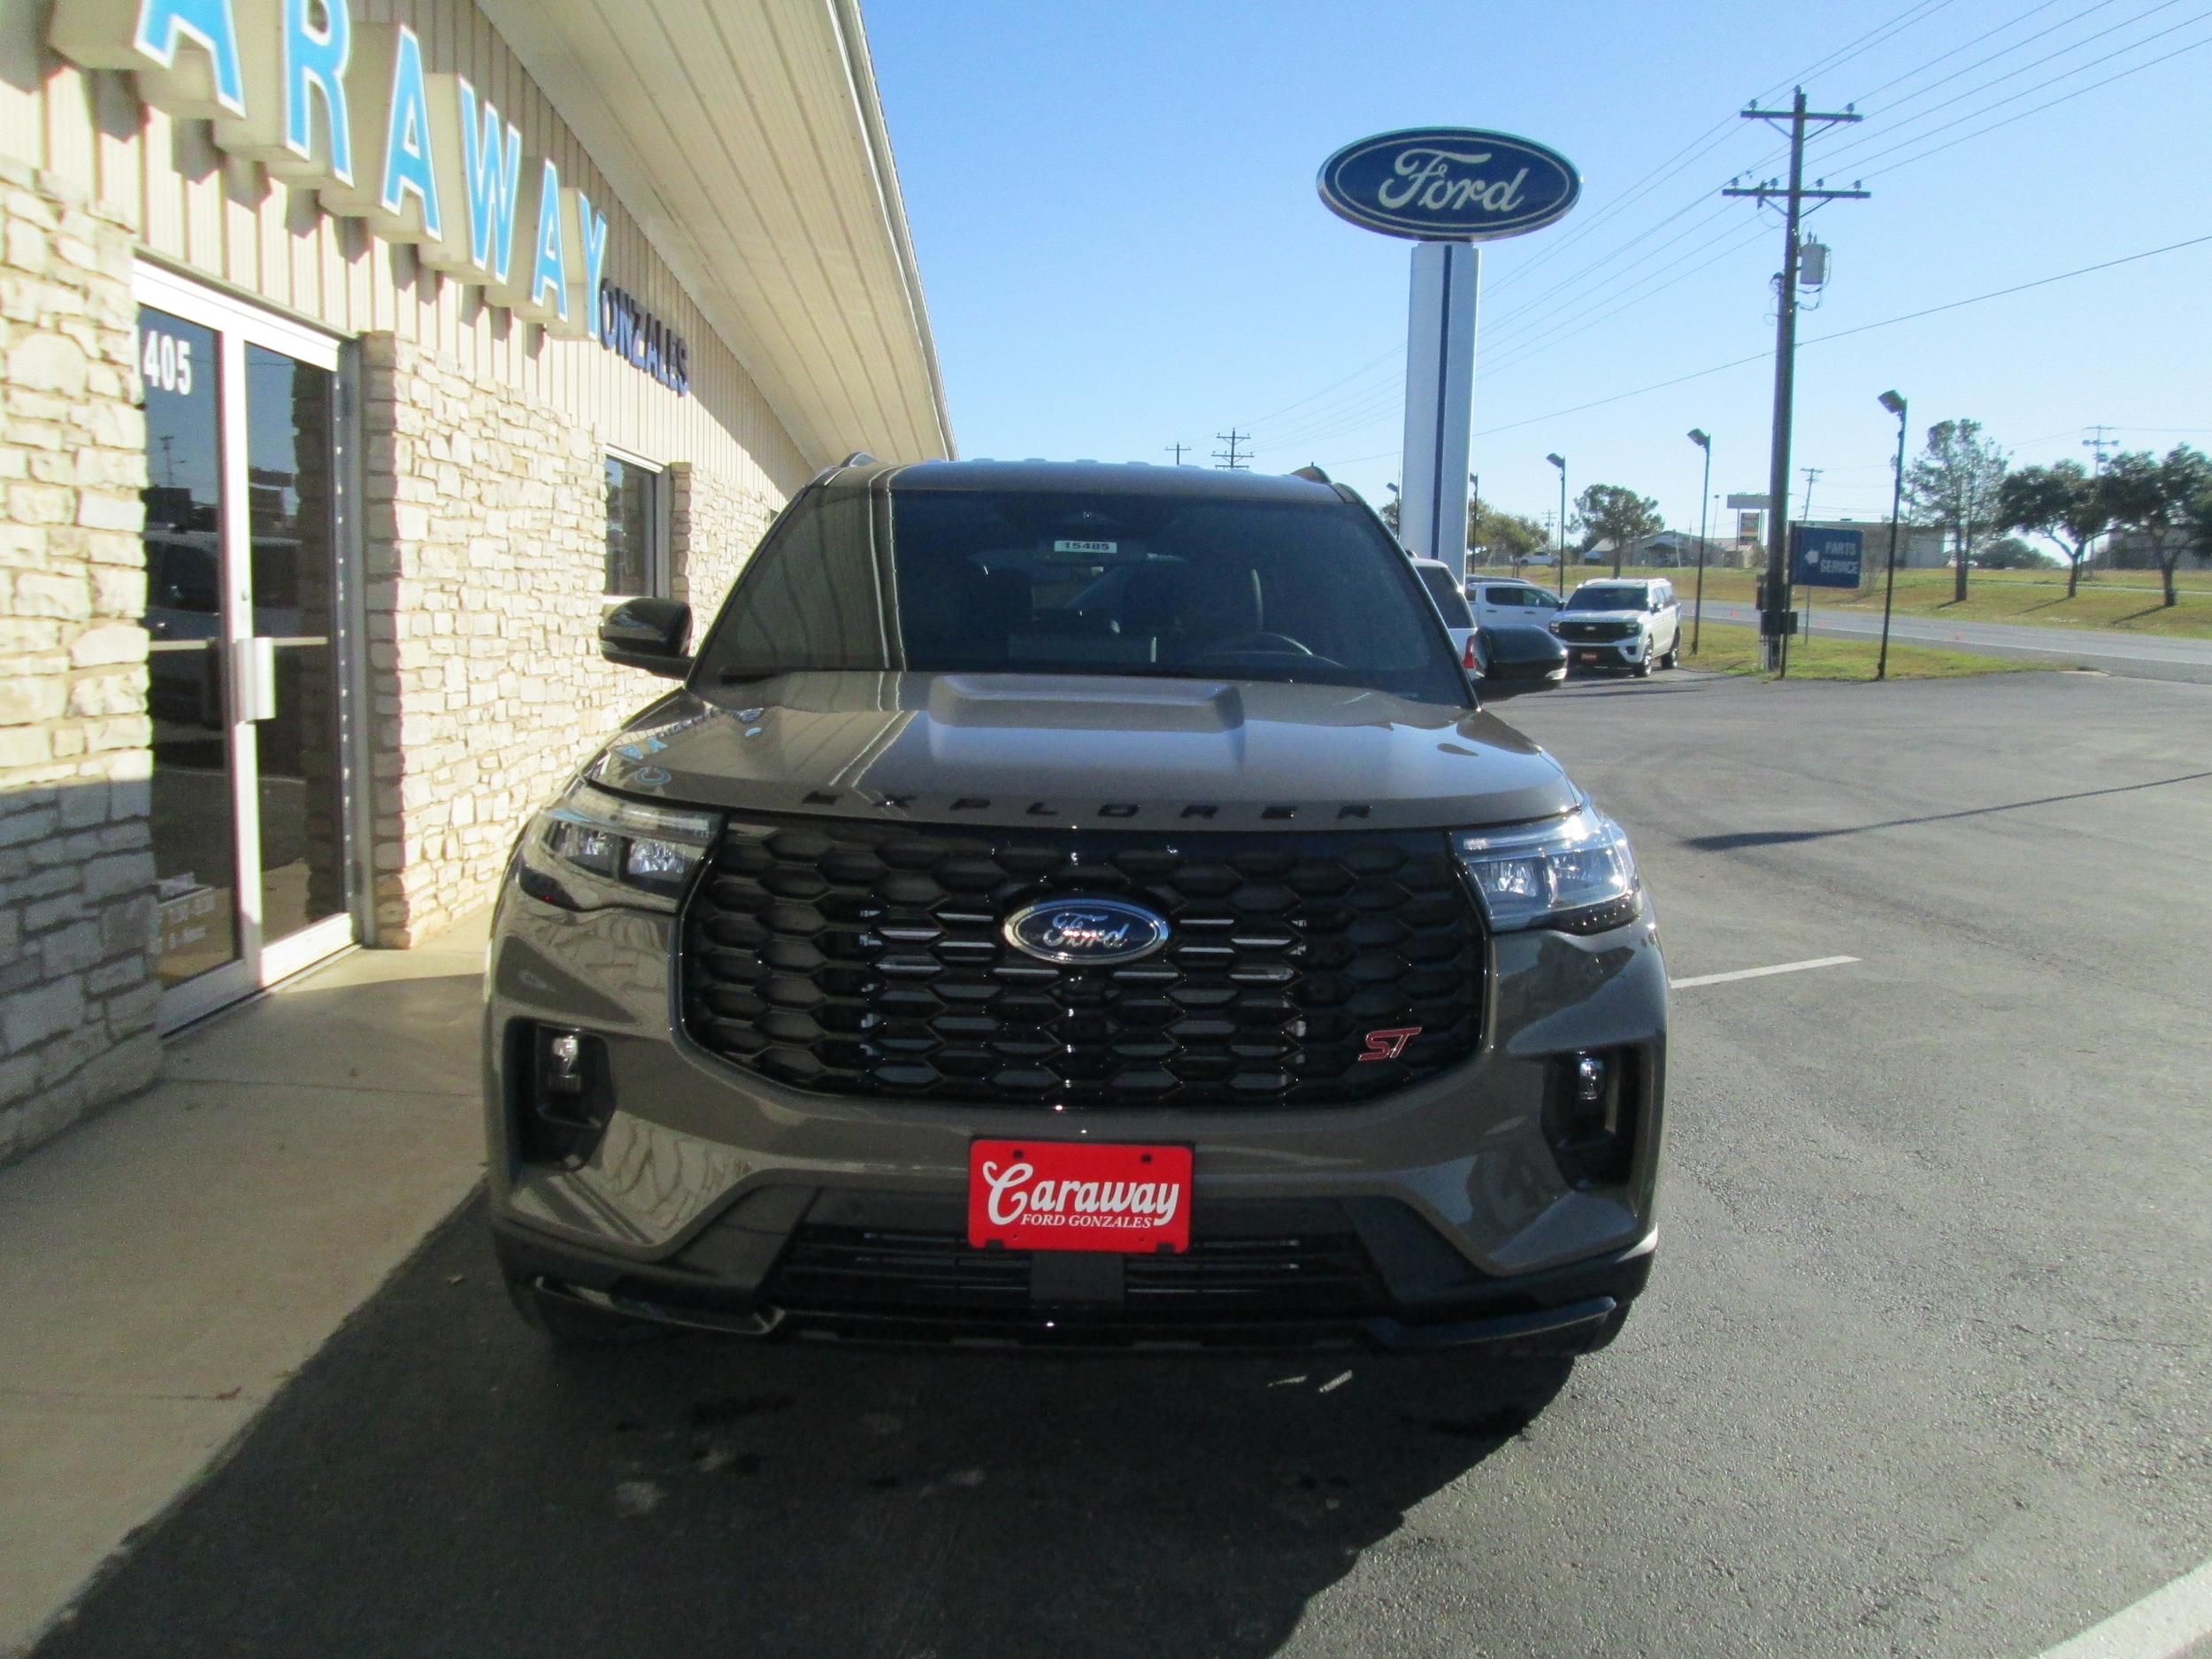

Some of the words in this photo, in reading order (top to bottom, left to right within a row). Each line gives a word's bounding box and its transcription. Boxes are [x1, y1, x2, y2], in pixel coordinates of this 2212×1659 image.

[1378, 148, 1529, 212] Ford
[600, 278, 687, 397] ONZALES
[1064, 541, 1110, 550] 15485
[1824, 541, 1856, 556] PARTS
[1820, 558, 1858, 574] SERVICE
[802, 790, 1371, 819] EXPLORER
[1043, 912, 1130, 948] Ford
[1358, 1026, 1422, 1061] ST
[982, 1161, 1179, 1225] Caraway
[1020, 1213, 1065, 1226] FORD
[1068, 1215, 1154, 1229] GONZALES
